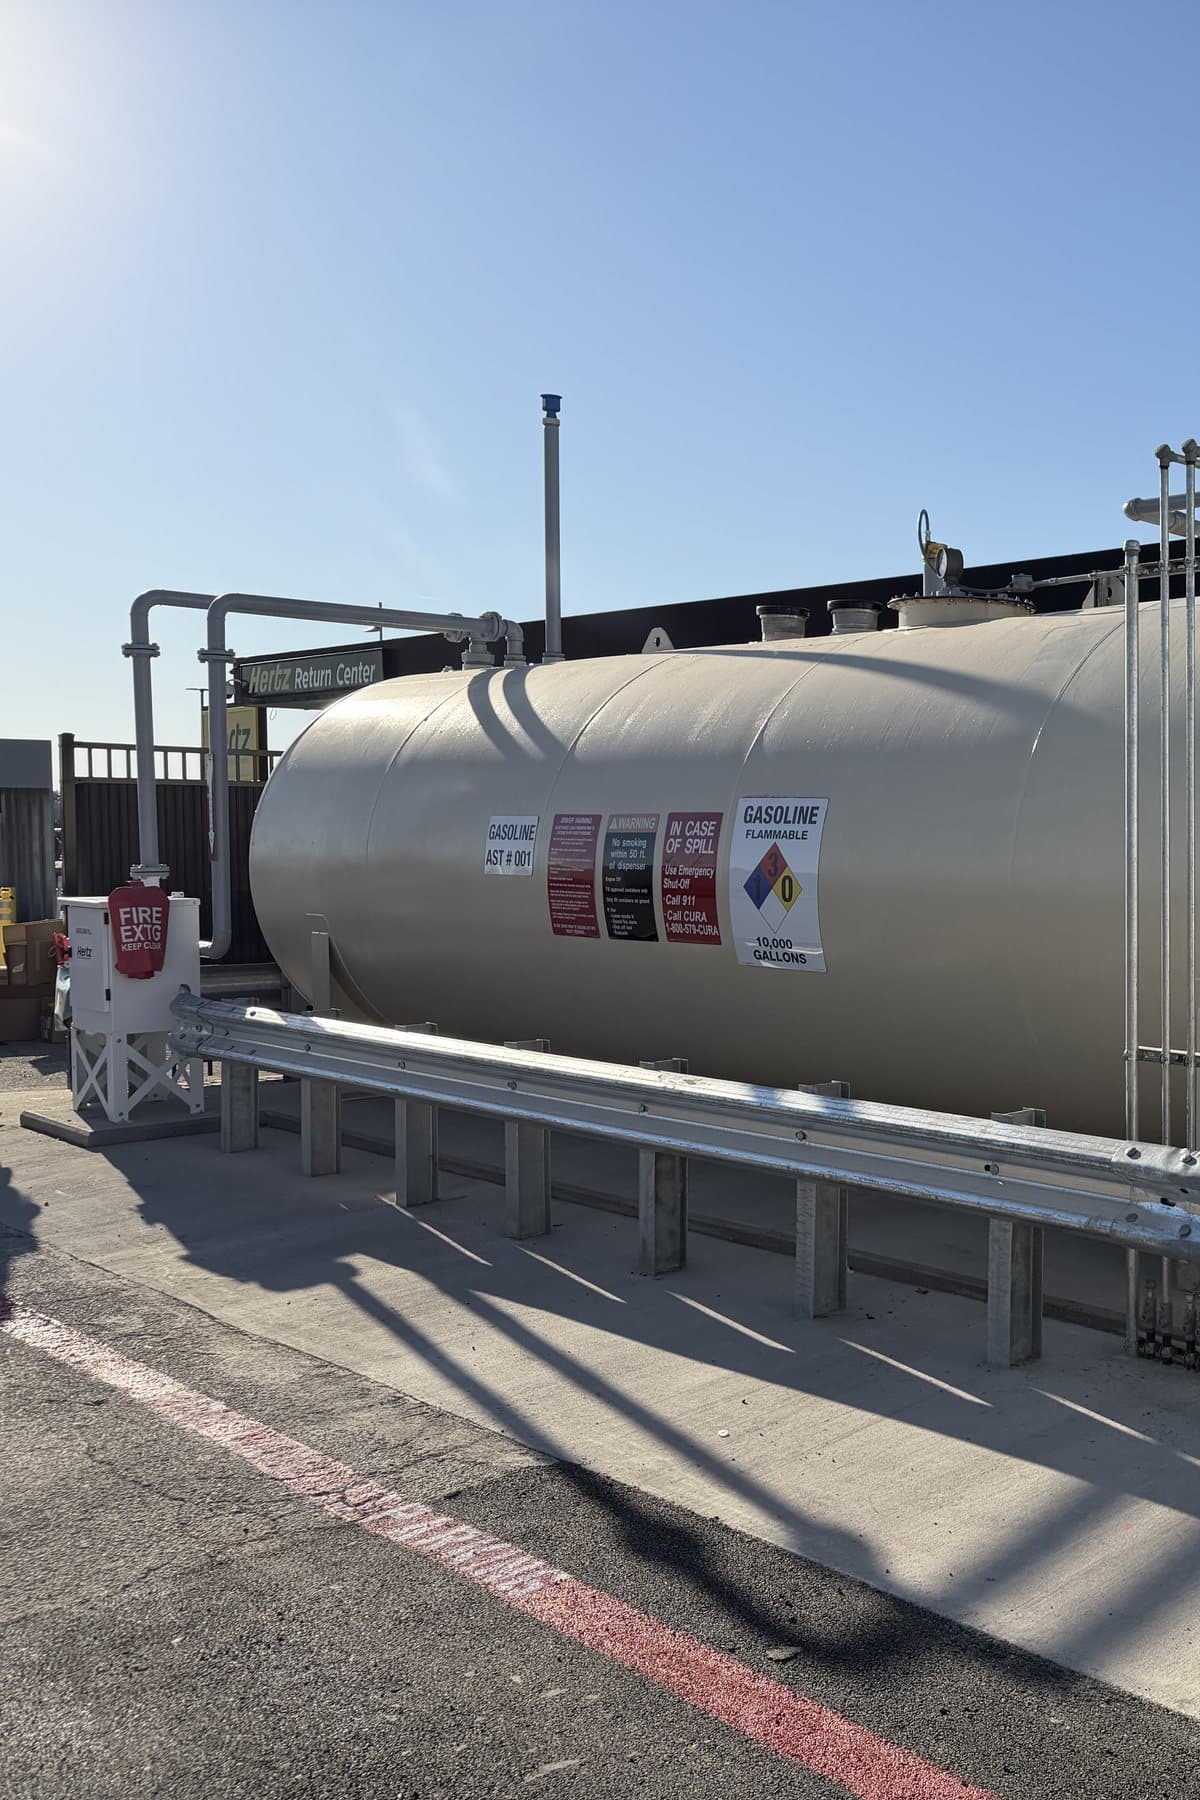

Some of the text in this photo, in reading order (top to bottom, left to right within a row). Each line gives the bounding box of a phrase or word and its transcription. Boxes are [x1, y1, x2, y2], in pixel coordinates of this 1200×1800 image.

[248, 663, 376, 694] Hertz Return Center
[229, 723, 251, 750] rtz
[743, 805, 820, 825] GASOLINE
[619, 817, 656, 829] WARNING
[670, 821, 717, 836] IN CASE
[489, 824, 536, 840] GASOLINE
[745, 829, 809, 840] FLAMMABLE
[612, 838, 647, 849] No smoking
[666, 838, 715, 854] OF SPILL
[486, 849, 531, 867] AST # 001
[610, 849, 628, 858] within
[629, 849, 638, 858] 50
[617, 861, 646, 872] dispenser
[665, 864, 714, 879] Use Emergency
[767, 852, 778, 877] 3
[663, 878, 690, 889] Shut-Off
[781, 875, 793, 903] 0
[666, 894, 695, 906] Call 911
[119, 907, 162, 925] FIRE
[667, 910, 707, 922] Call CURA
[120, 924, 162, 943] EXTG
[121, 942, 141, 952] KEEP
[755, 937, 793, 950] 10,000
[753, 950, 807, 965] GALLONS
